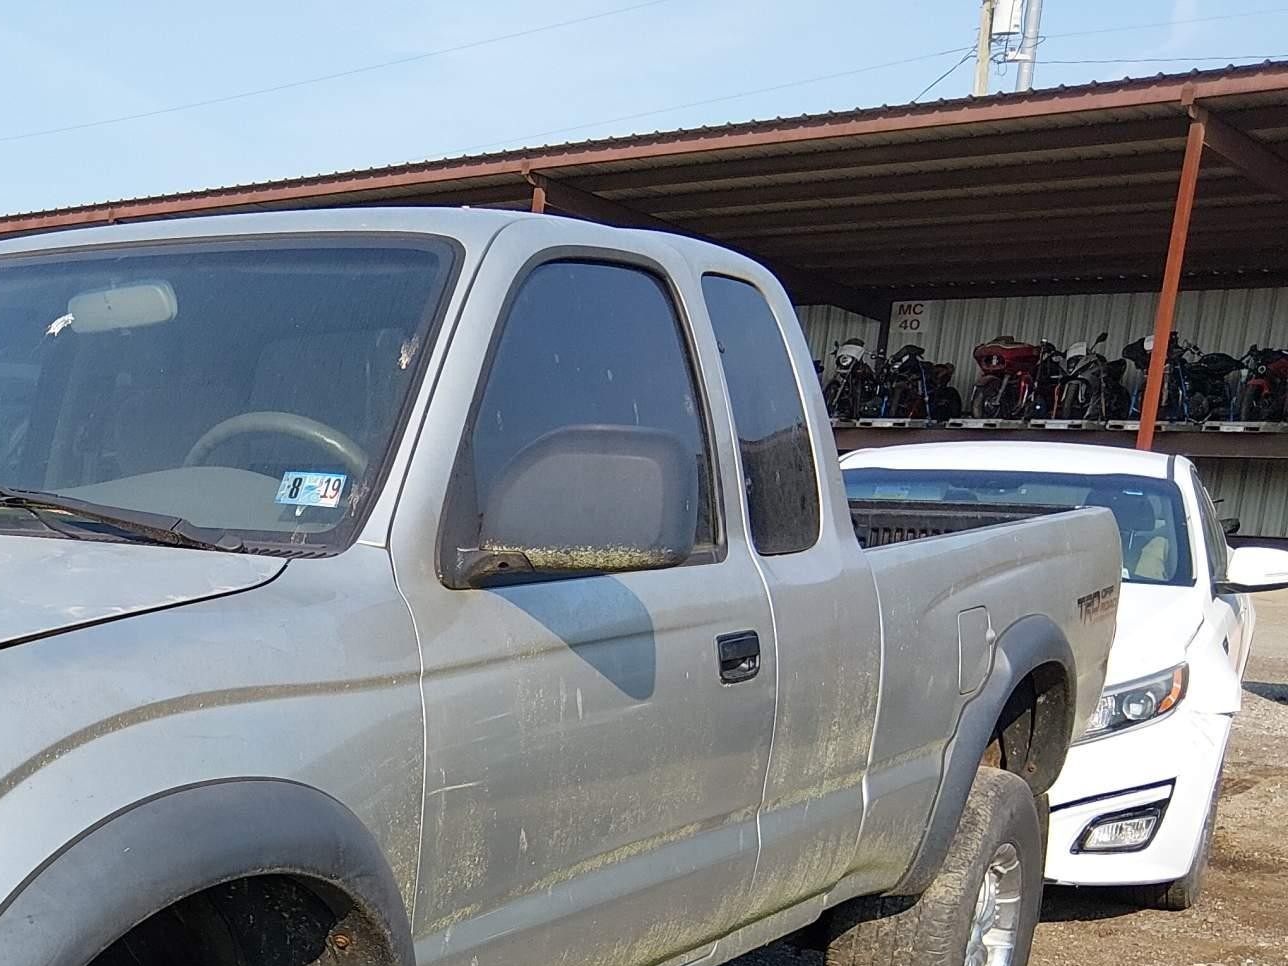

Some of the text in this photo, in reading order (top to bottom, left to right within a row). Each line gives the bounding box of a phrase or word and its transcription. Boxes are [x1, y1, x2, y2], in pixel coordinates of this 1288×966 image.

[898, 303, 924, 316] MC
[898, 318, 921, 331] 40
[319, 477, 342, 500] 19
[1077, 590, 1101, 625] TRD
